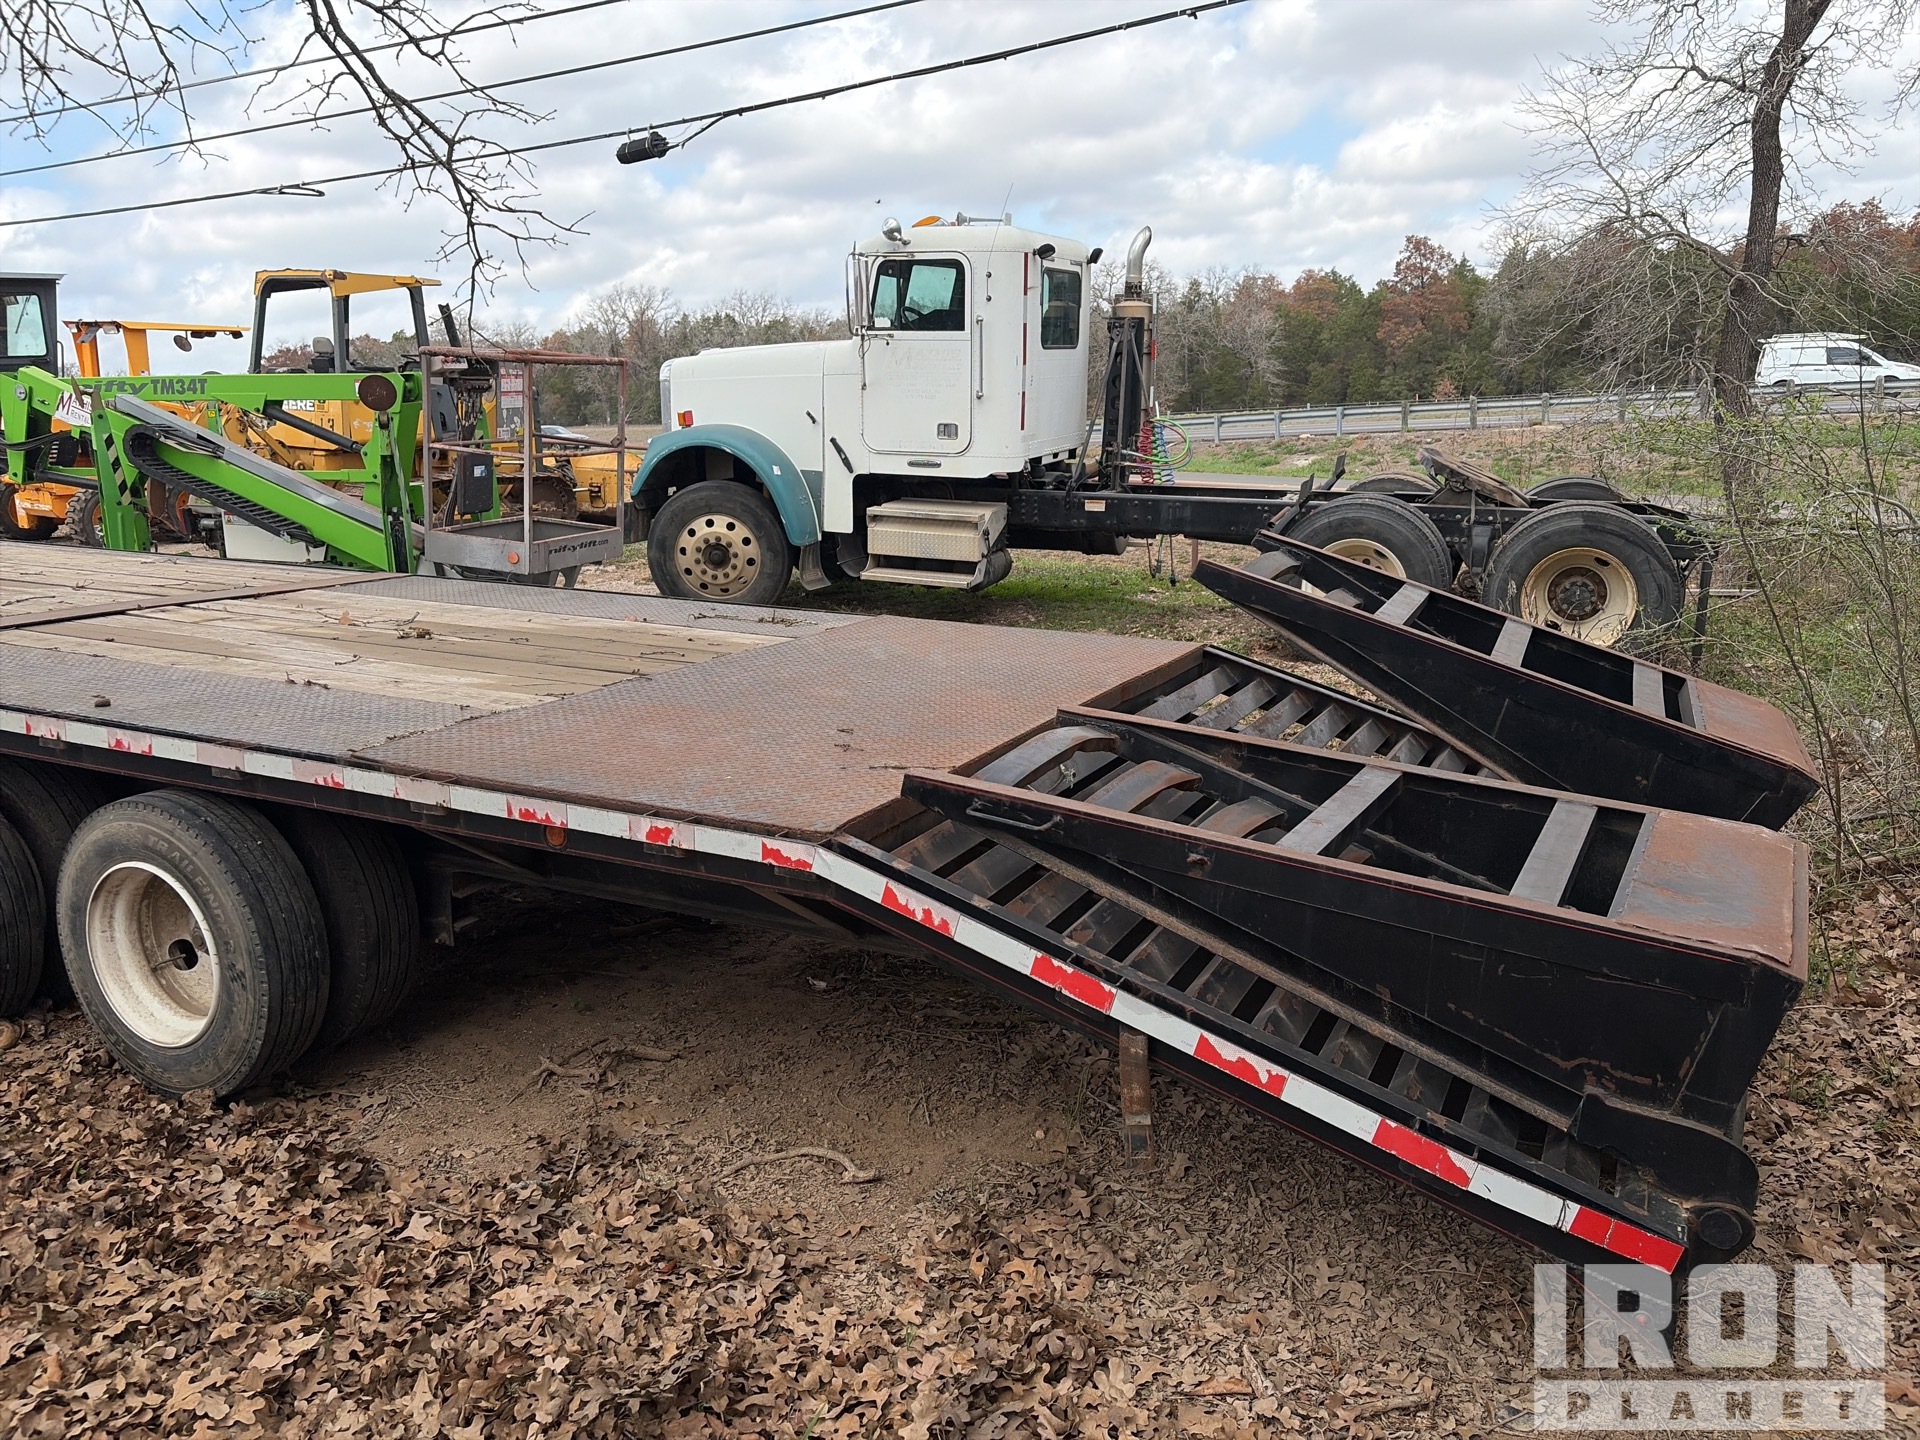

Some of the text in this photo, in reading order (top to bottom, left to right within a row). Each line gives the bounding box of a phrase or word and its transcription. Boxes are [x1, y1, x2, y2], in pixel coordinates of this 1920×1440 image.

[151, 378, 208, 395] TM34T
[56, 391, 92, 416] MAHI
[70, 409, 90, 424] RENTAL
